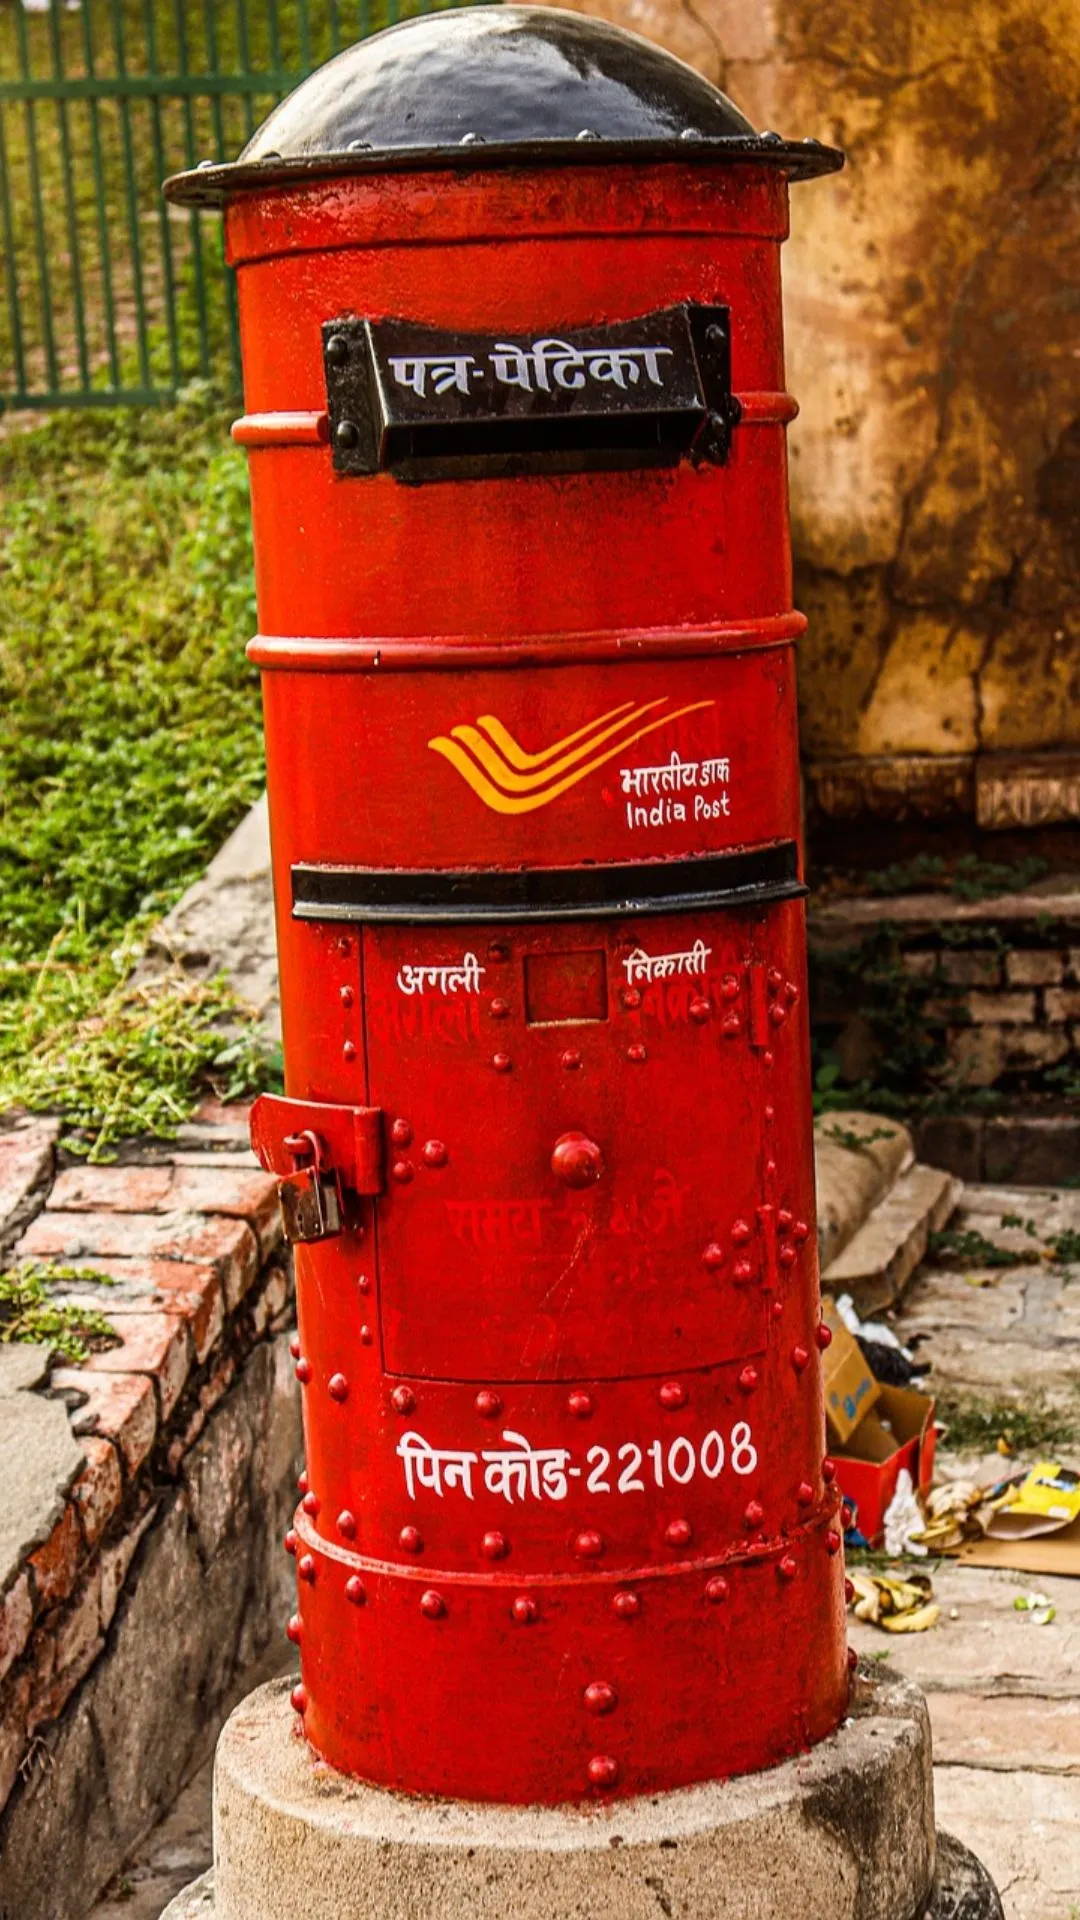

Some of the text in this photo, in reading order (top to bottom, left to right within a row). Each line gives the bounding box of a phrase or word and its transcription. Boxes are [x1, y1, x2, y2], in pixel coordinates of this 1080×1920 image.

[387, 338, 674, 399] पत्र-पेटिका
[619, 750, 730, 798] भारतीय डाक
[626, 789, 731, 830] India Post
[396, 952, 486, 996] अगली
[621, 938, 712, 986] निकासी
[396, 1430, 478, 1500] पिन
